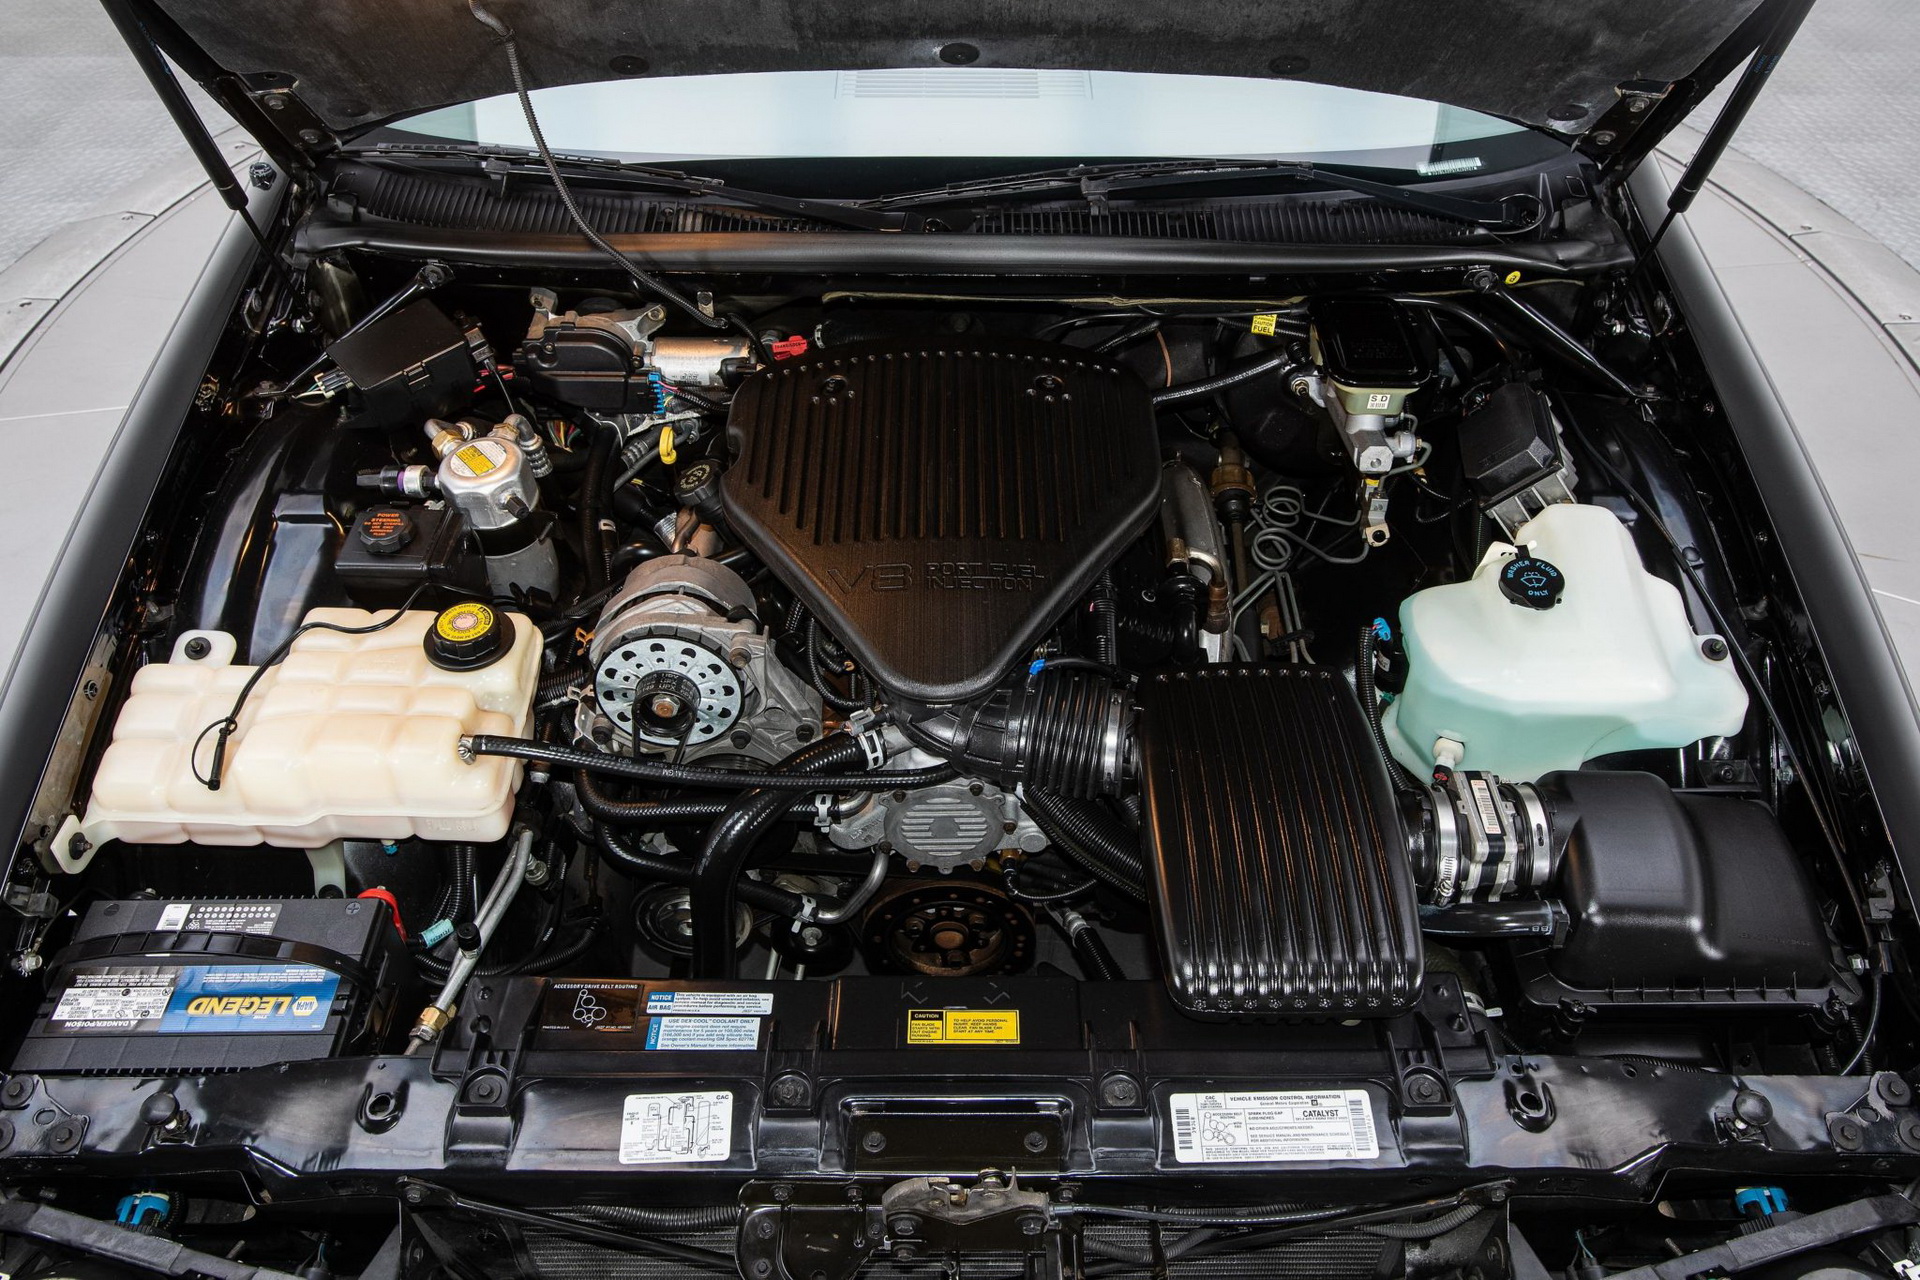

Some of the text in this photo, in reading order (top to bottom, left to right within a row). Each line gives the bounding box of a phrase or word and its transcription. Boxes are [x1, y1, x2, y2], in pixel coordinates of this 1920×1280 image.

[1253, 325, 1272, 334] FUEL
[827, 562, 1044, 595] V8 PORT FUEL
[1506, 560, 1558, 579] WASHER FLUID
[926, 576, 1032, 591] INJECTION
[186, 996, 315, 1017] NAPA LEGEND
[650, 1024, 659, 1045] NOTICE
[1302, 1109, 1339, 1117] CATALYST
